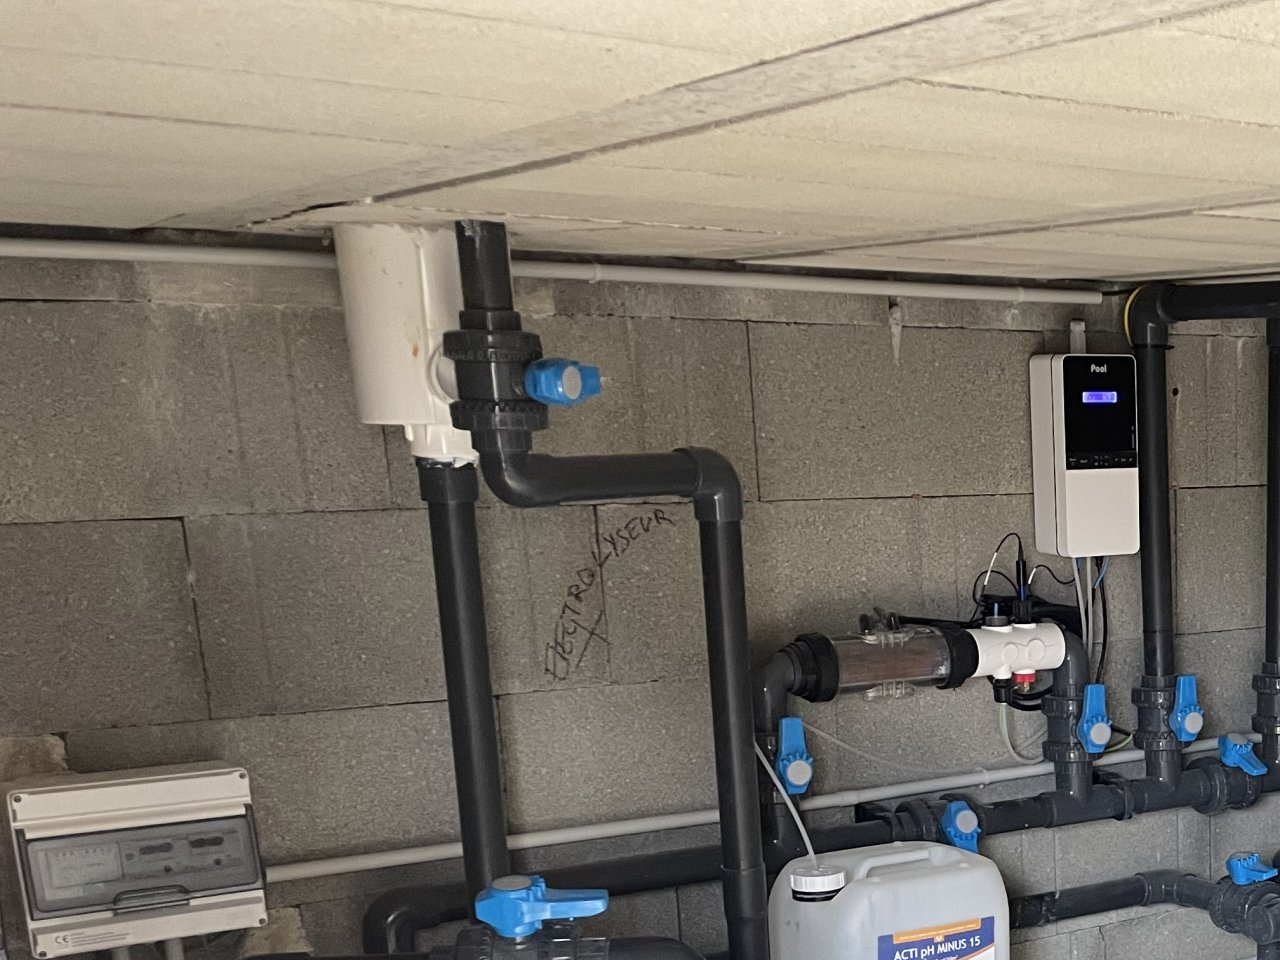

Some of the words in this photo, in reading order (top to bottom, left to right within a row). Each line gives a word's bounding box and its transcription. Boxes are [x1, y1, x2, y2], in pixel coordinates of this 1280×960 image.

[1090, 364, 1107, 373] Pool
[920, 945, 934, 959] pH
[936, 938, 967, 954] MINUS
[969, 935, 981, 947] 15
